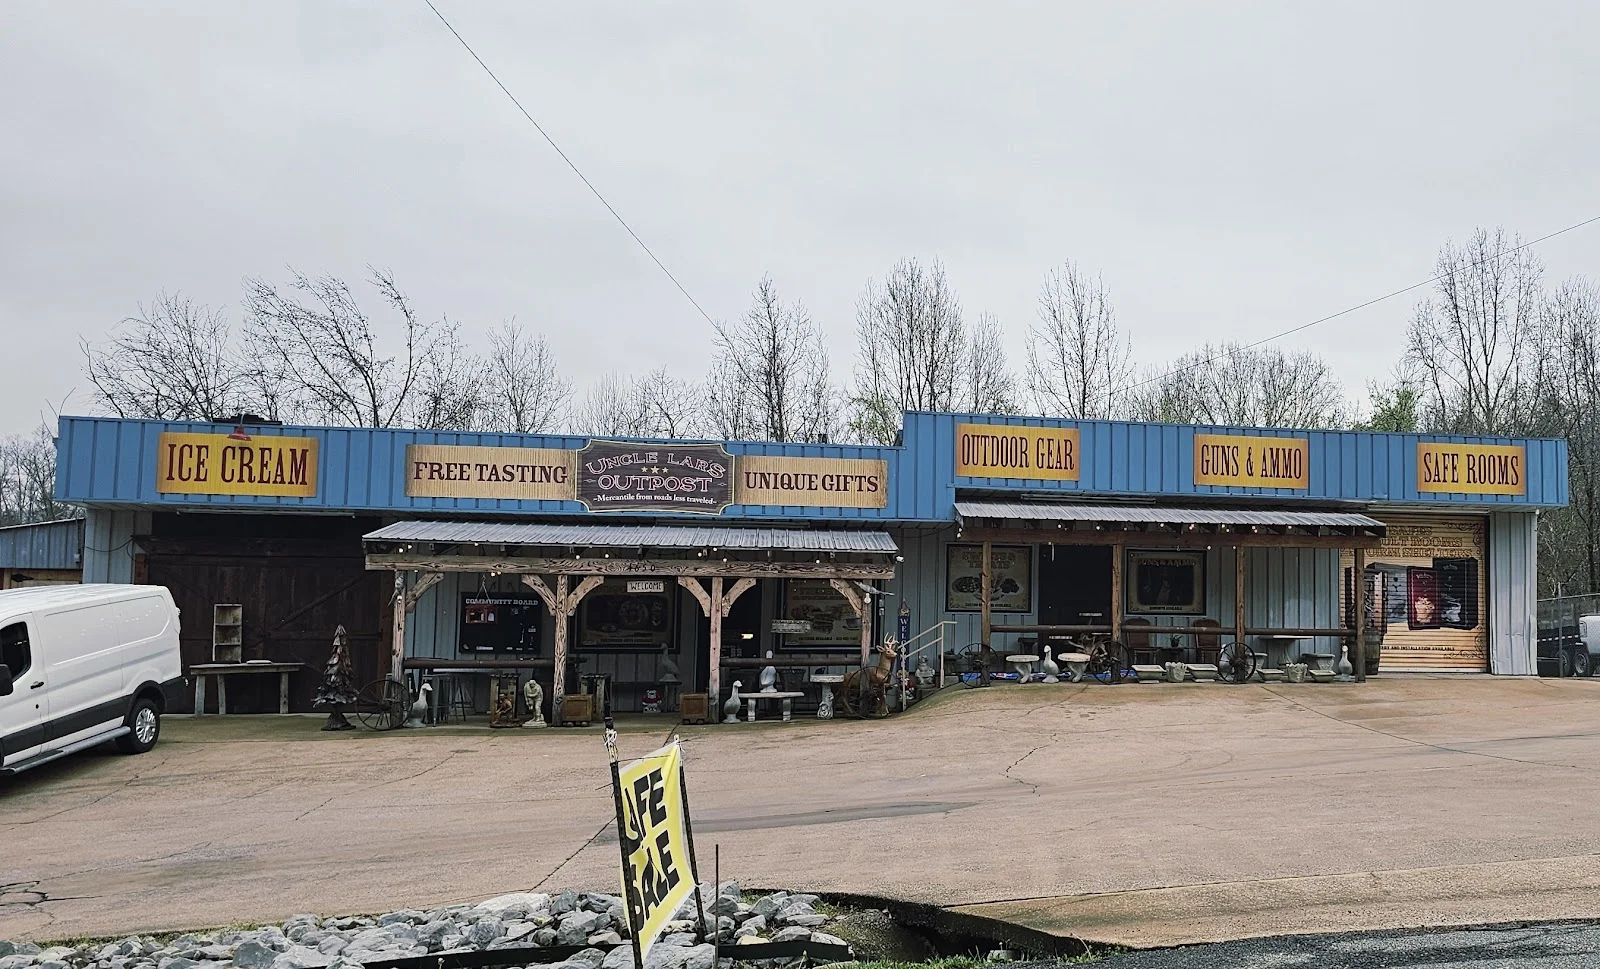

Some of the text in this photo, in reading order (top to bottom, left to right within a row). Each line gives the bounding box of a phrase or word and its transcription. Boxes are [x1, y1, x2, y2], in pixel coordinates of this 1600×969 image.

[962, 433, 1075, 471] OUTDOOR GEAR
[1201, 444, 1302, 480] GUNS & AMMO
[166, 443, 309, 486] ICE CREAM
[413, 461, 568, 484] FREE TASTING
[585, 451, 726, 479] UNCLE LAR'S
[1423, 452, 1519, 486] SAFE ROOMS
[597, 475, 713, 492] OUTPOST
[744, 471, 879, 493] UNIQUE GIFTS
[636, 493, 653, 501] from
[653, 493, 672, 501] roads
[673, 494, 686, 502] less
[1402, 547, 1473, 557] SHELTERS
[1411, 537, 1463, 547] ROOMS
[629, 582, 662, 591] WELCOME
